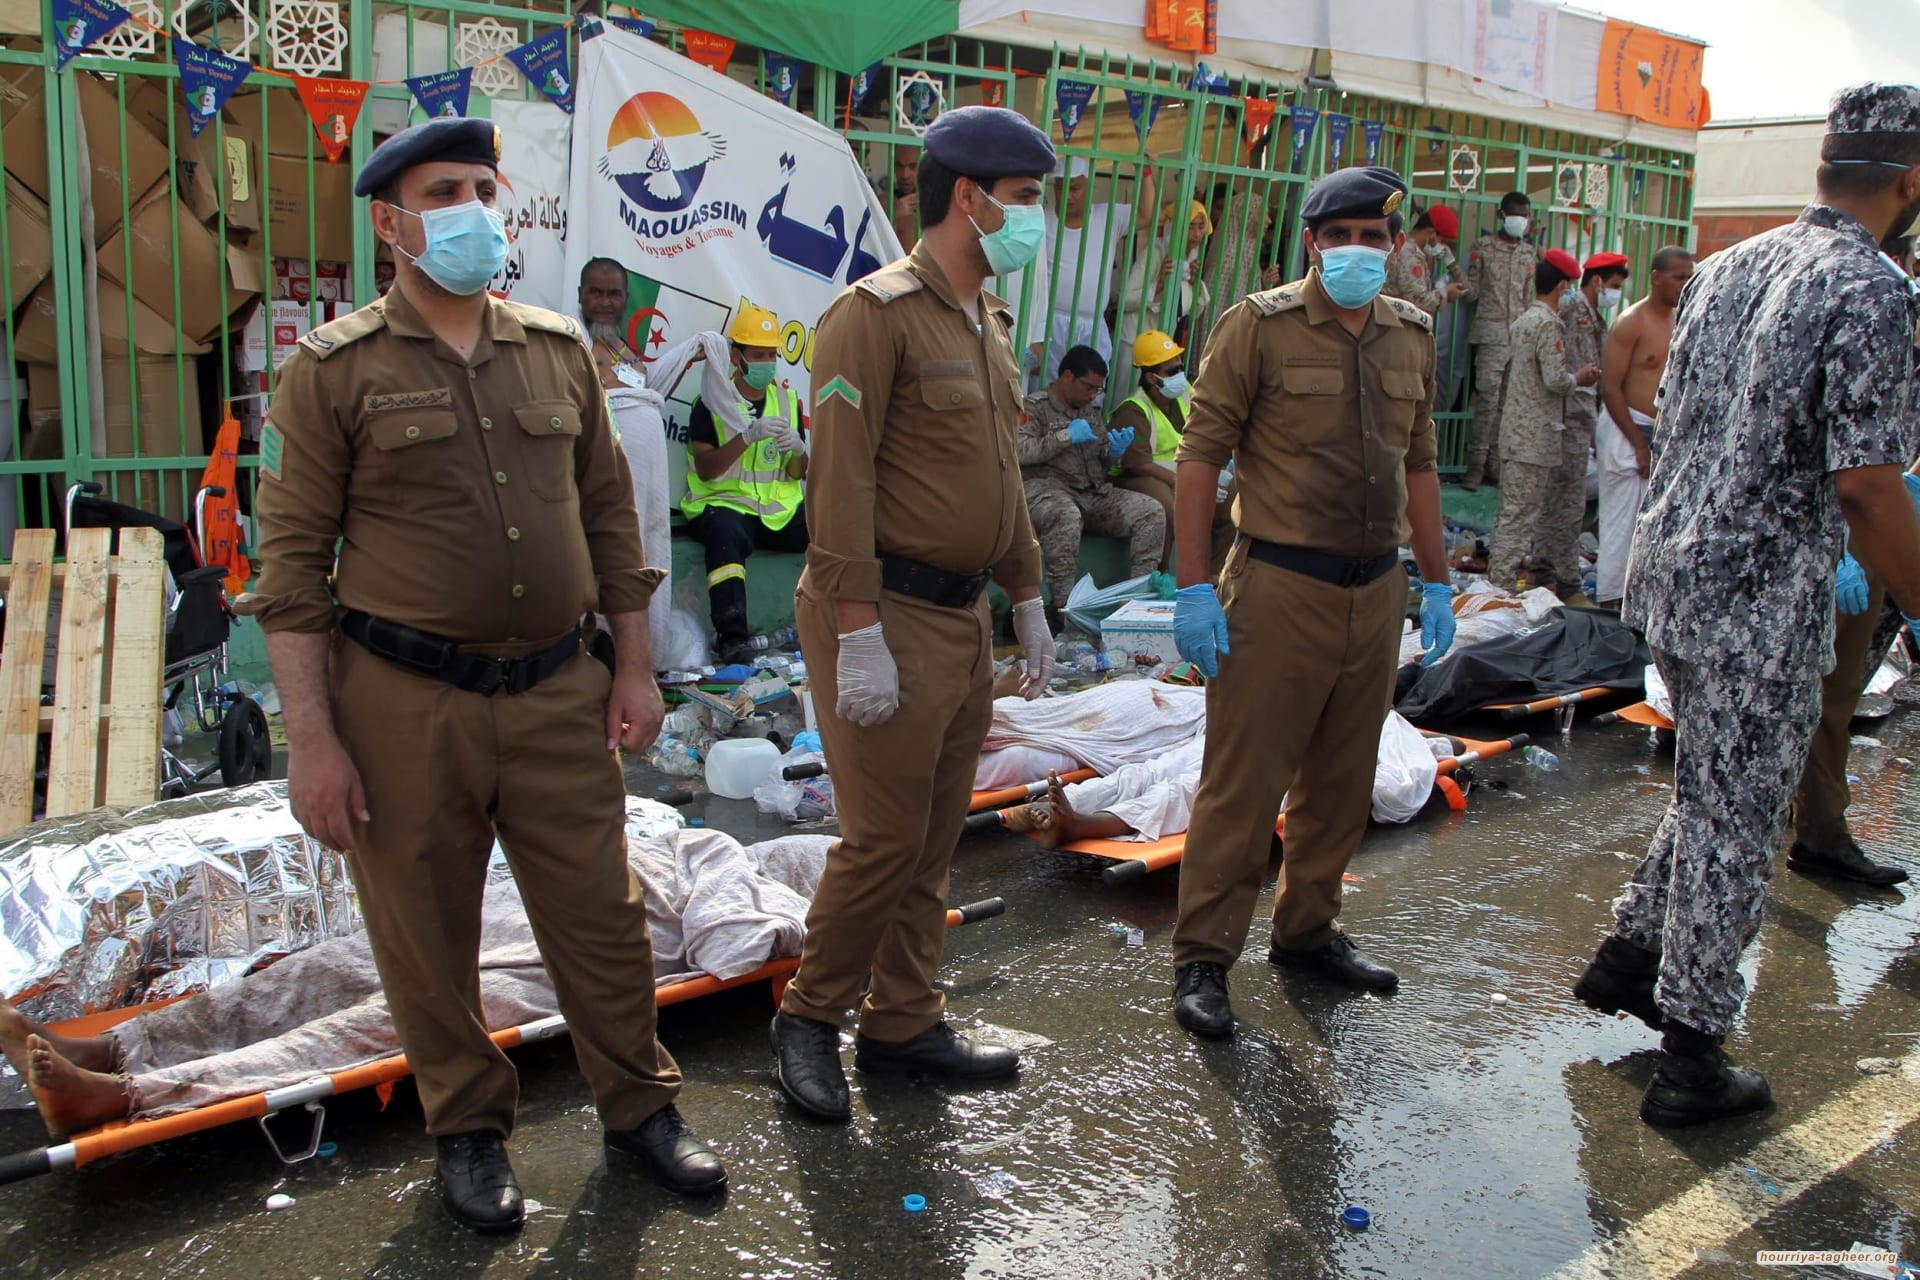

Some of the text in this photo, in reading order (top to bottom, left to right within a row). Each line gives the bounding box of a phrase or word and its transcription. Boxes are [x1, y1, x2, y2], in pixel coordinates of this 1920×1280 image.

[503, 194, 567, 242] وكالة الحرم
[619, 197, 748, 239] MAOUASSIM
[634, 237, 683, 258] Voyages
[685, 236, 696, 250] &
